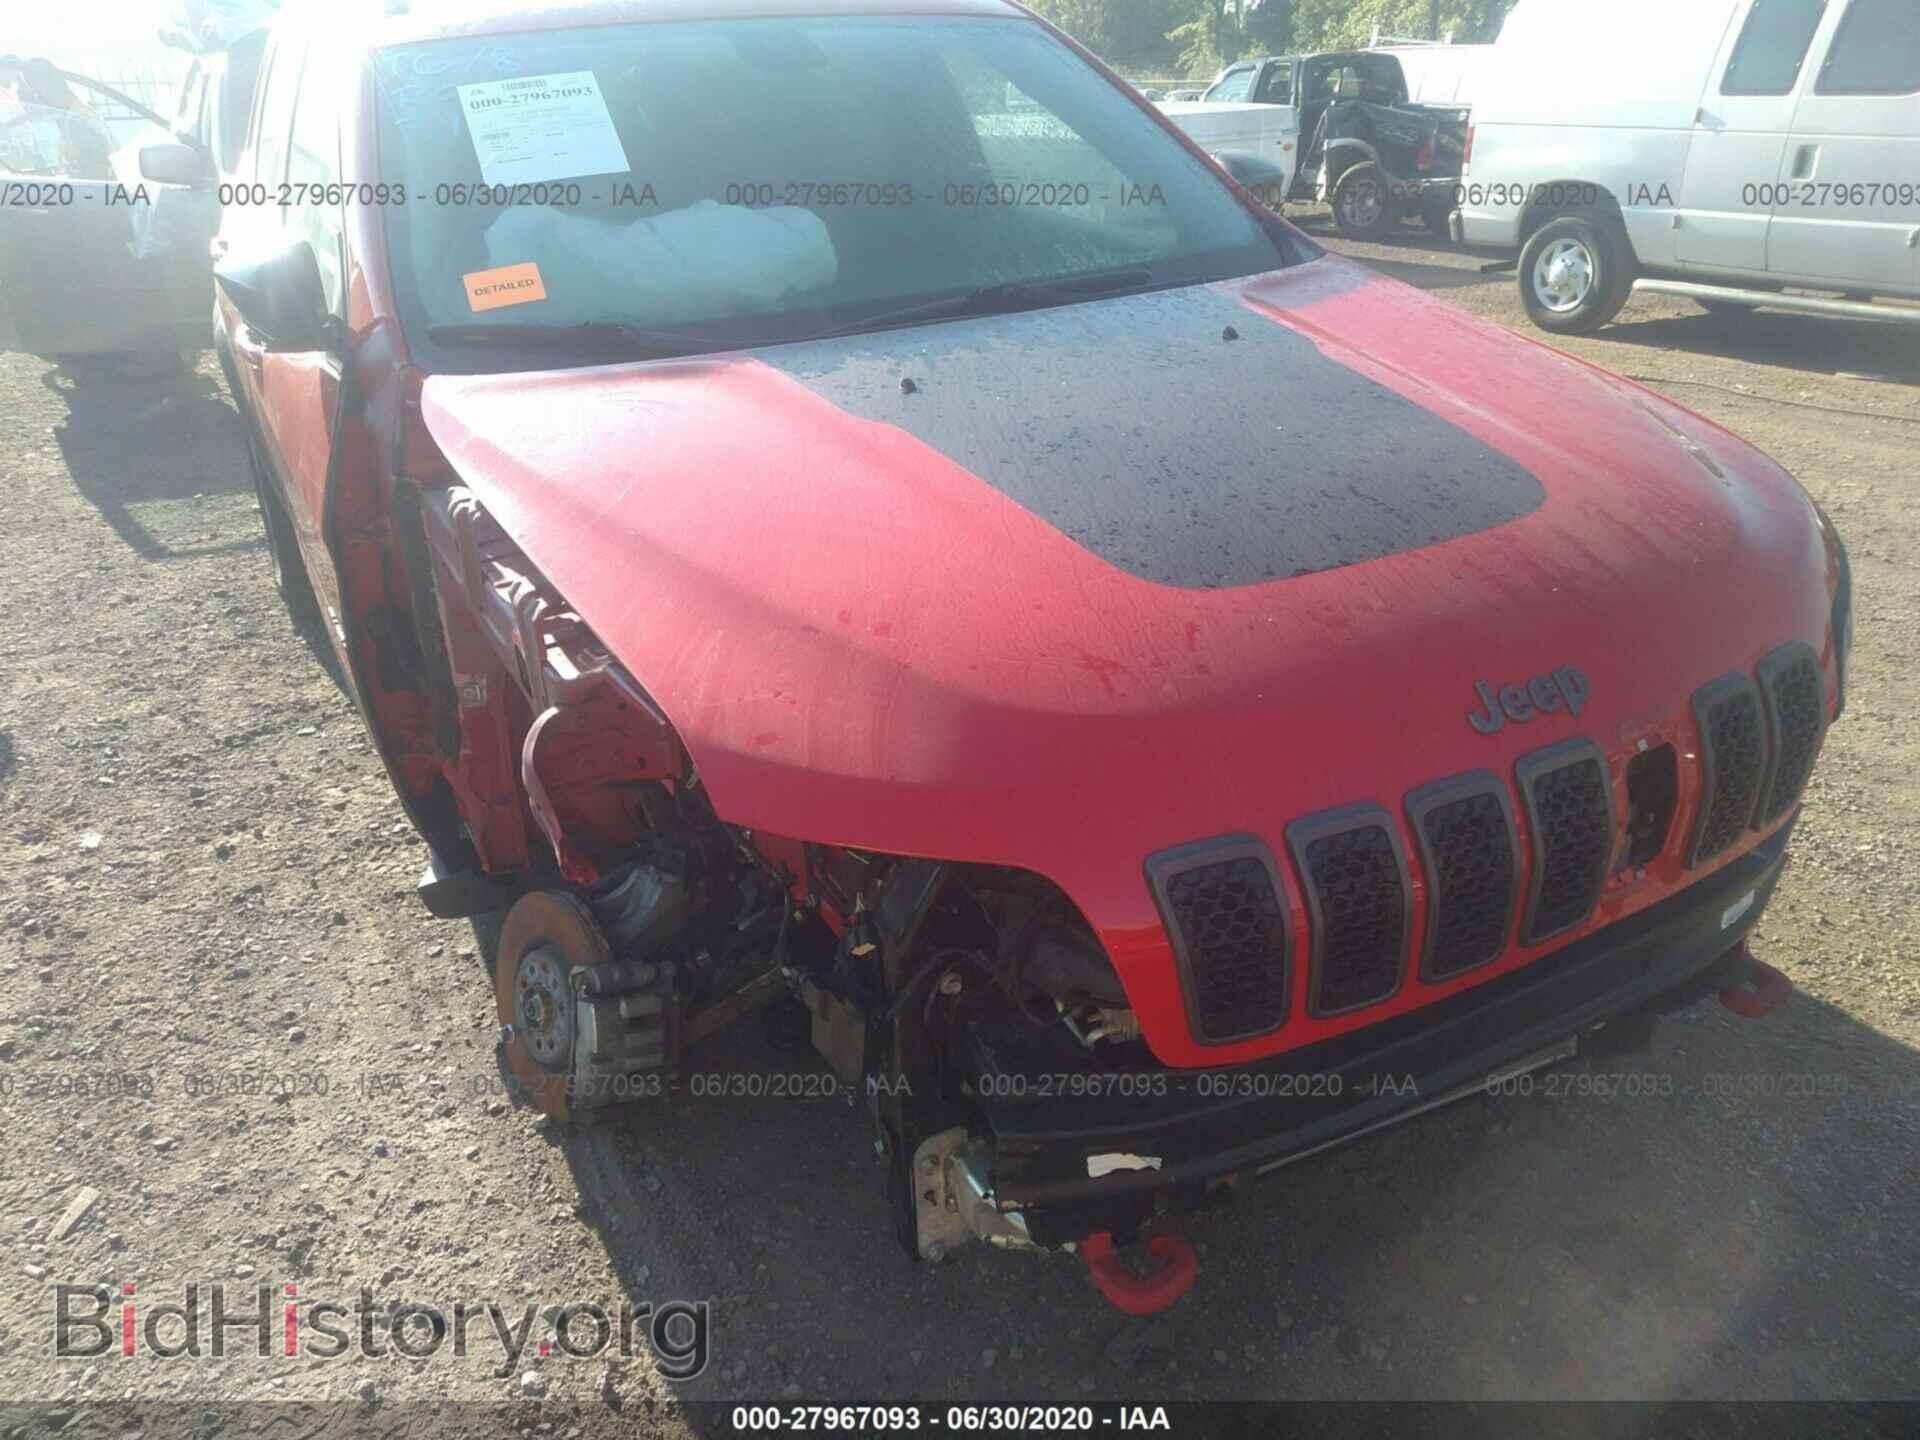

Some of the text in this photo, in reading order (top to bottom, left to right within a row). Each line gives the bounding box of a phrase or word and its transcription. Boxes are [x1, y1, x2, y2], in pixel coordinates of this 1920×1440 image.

[470, 87, 593, 111] 000-27967093
[474, 279, 535, 296] DETAILED
[1466, 665, 1590, 734] Jeep
